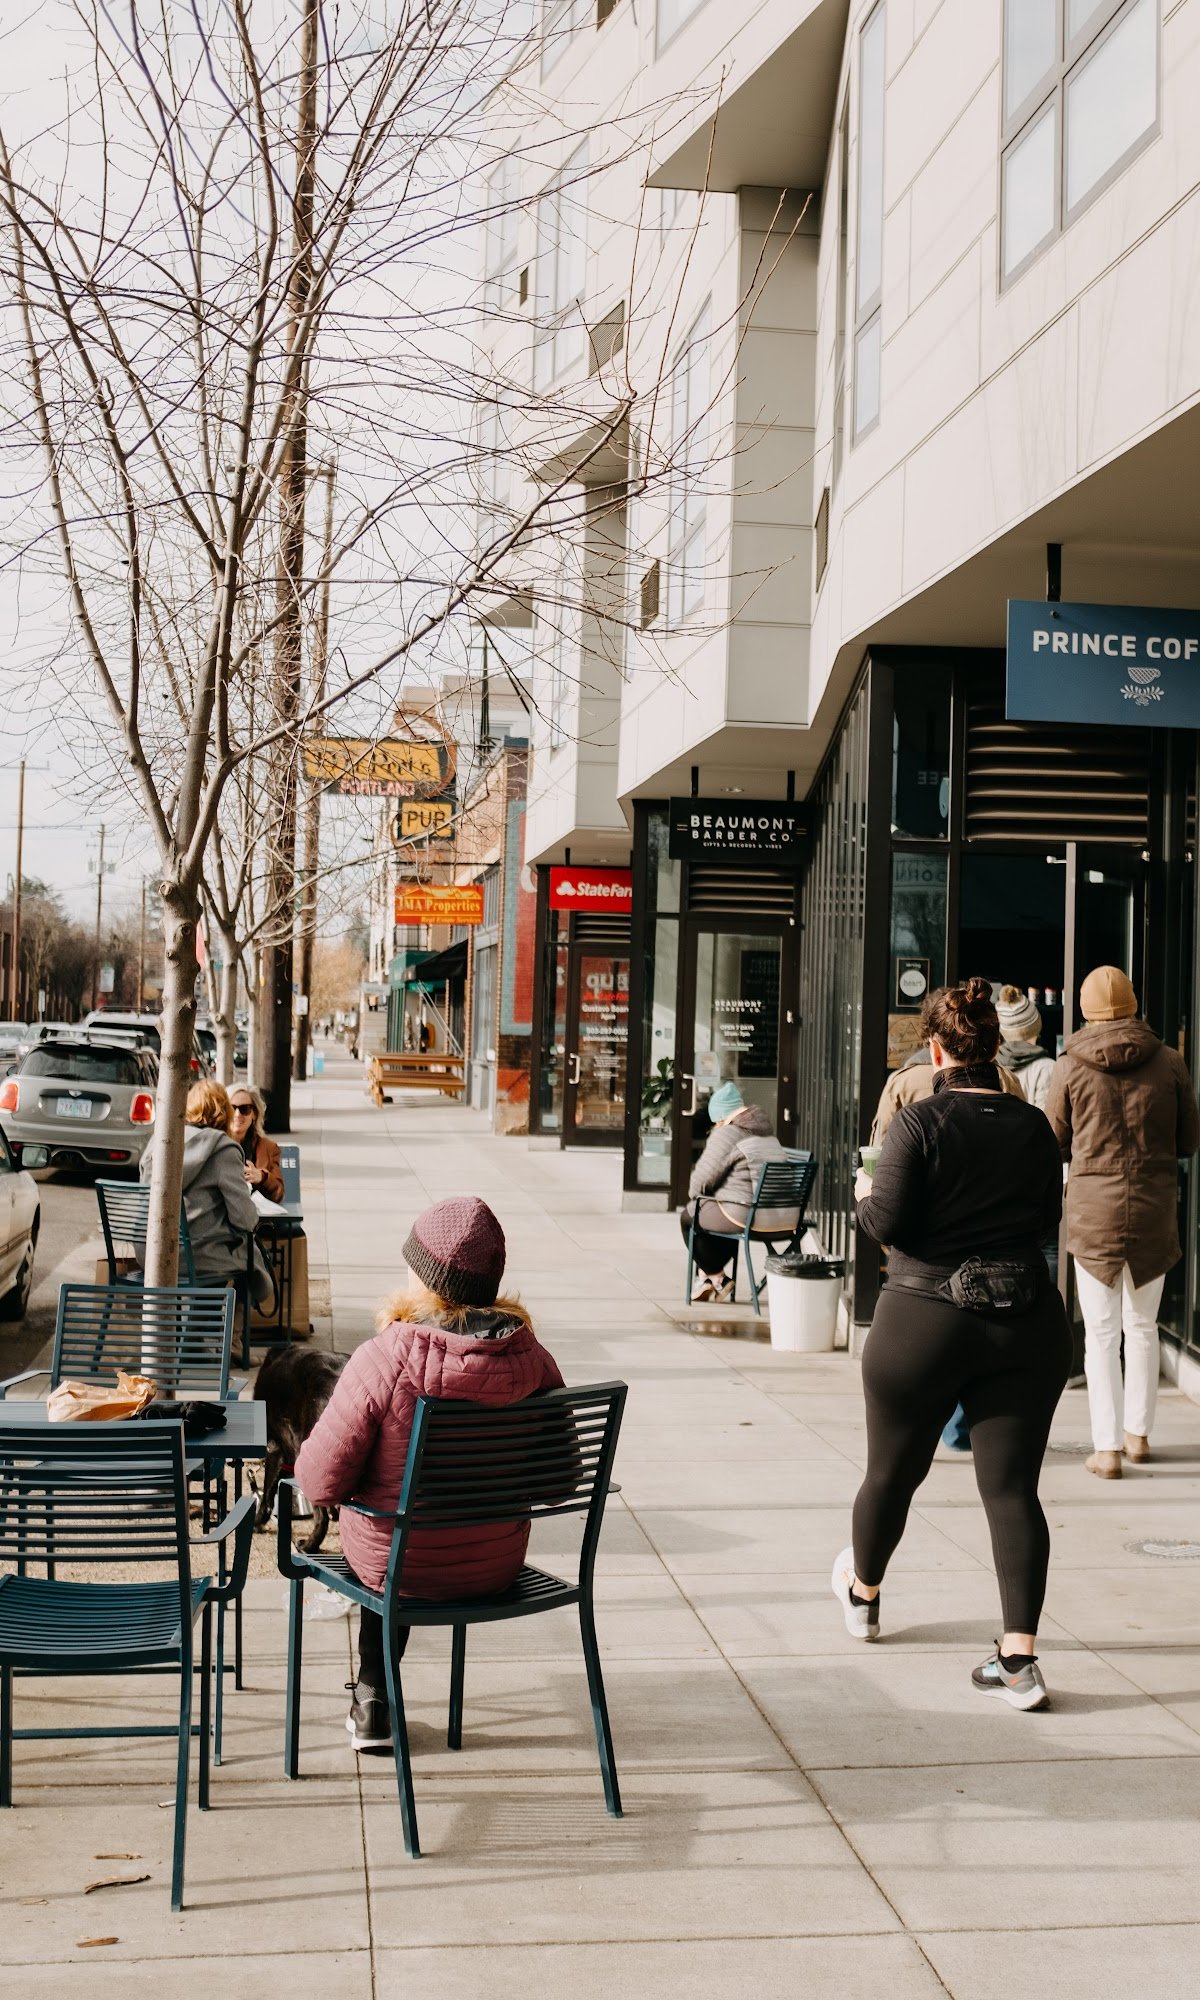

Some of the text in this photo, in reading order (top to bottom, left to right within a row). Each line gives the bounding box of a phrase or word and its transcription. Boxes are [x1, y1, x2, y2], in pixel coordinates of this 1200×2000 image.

[1032, 630, 1200, 661] PRINCE COF
[339, 779, 416, 797] PORTLAND
[407, 810, 447, 829] PUB
[690, 814, 796, 831] BEAUMONT
[691, 830, 794, 843] BARBER CO.
[425, 898, 481, 914] Properties
[714, 999, 762, 1007] BEAUMONT
